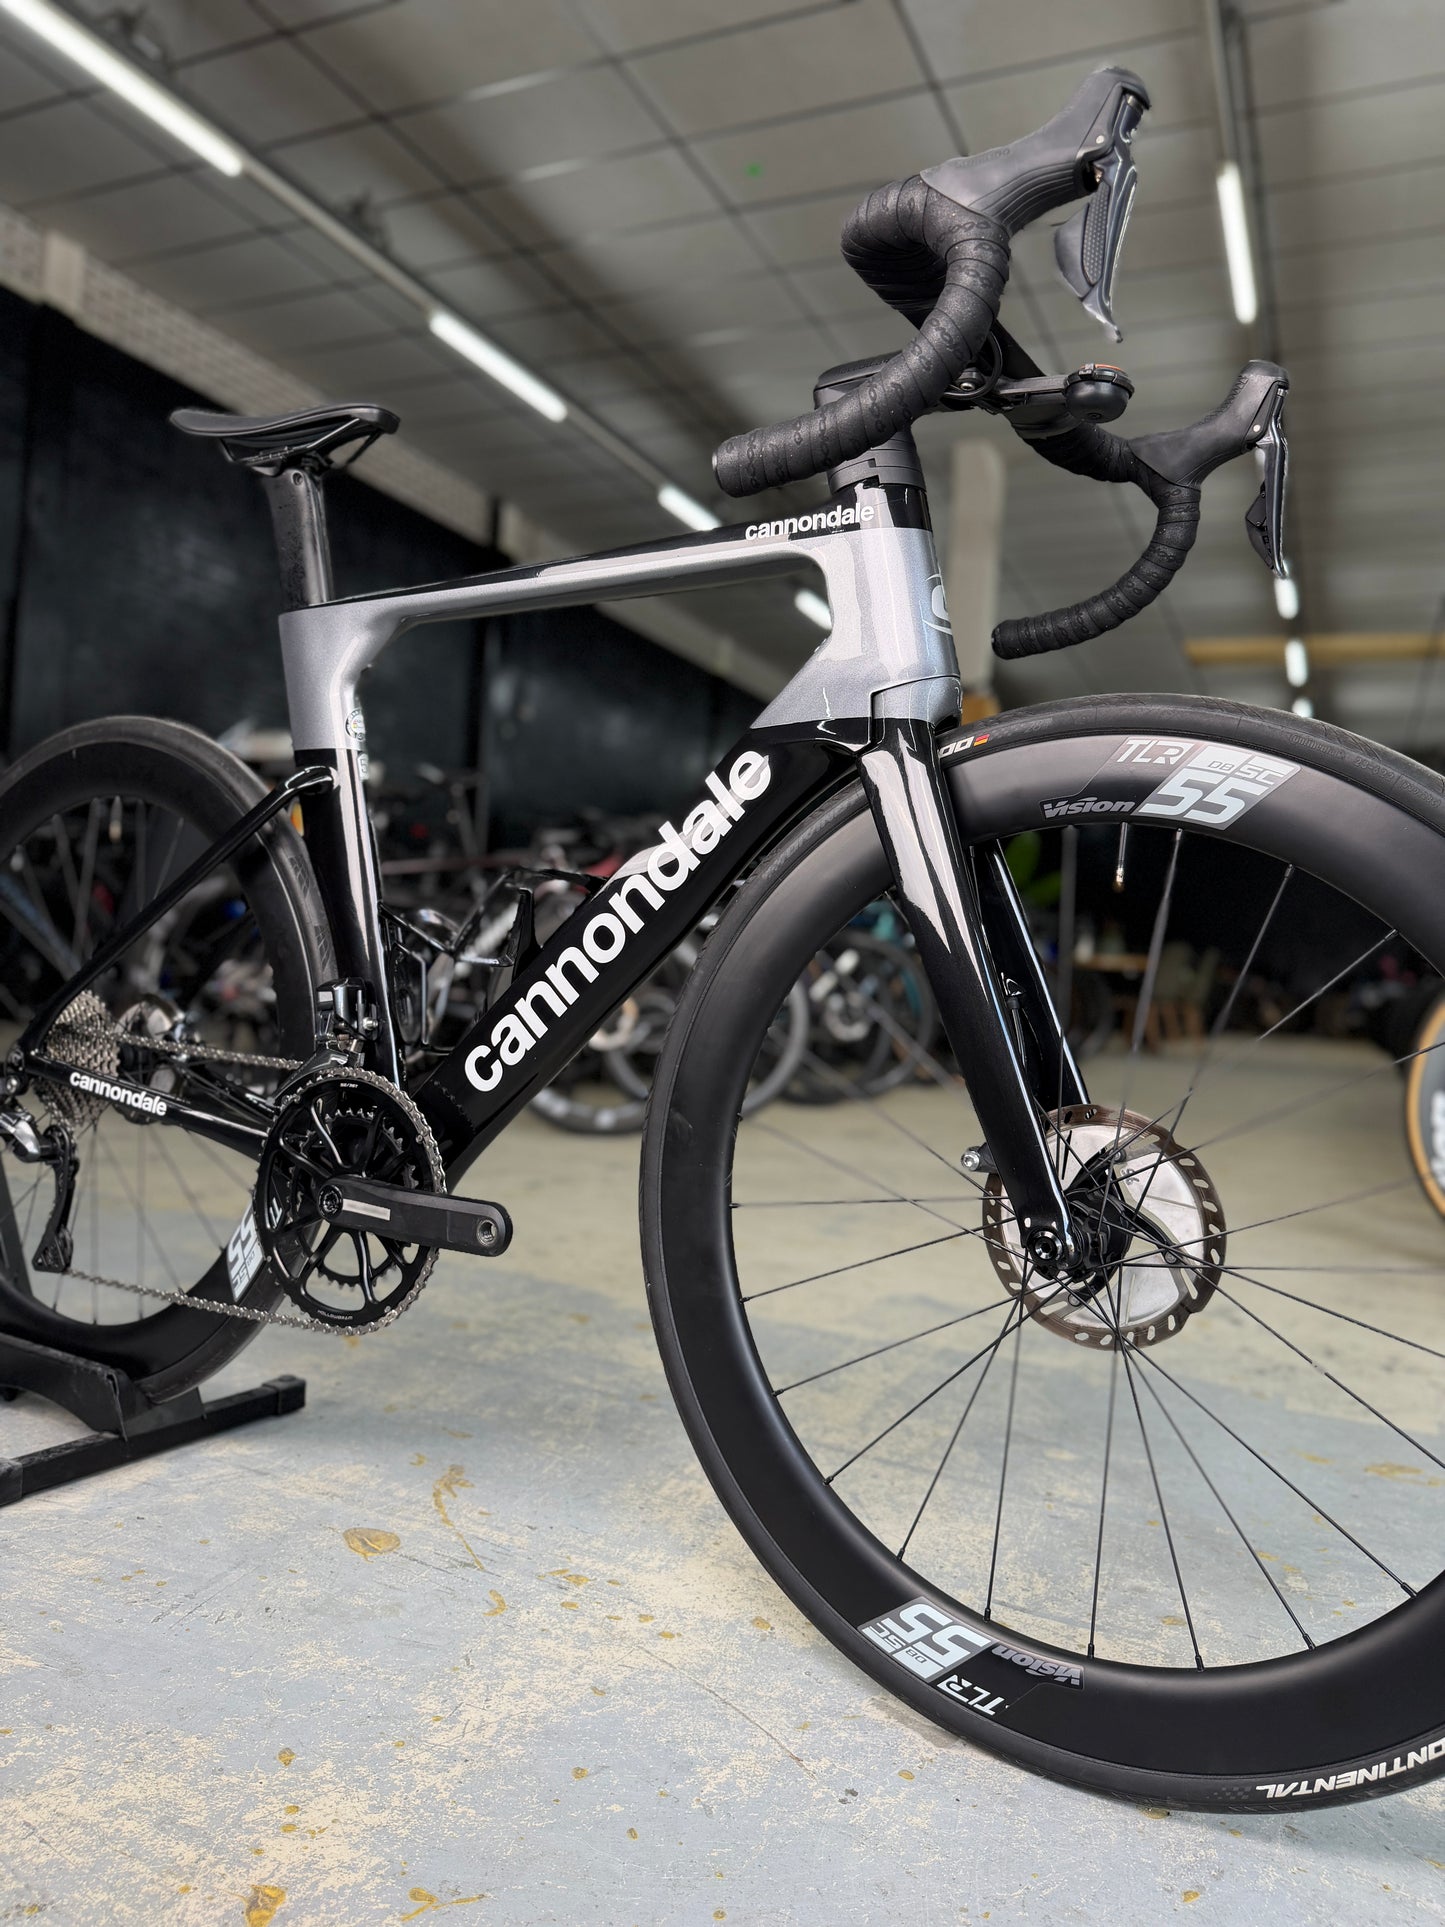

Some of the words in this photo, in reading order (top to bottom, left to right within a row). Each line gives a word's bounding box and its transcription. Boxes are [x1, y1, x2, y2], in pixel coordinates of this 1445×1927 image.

[745, 504, 875, 541] cannondale
[1116, 739, 1195, 765] TLR
[1208, 760, 1235, 772] DB
[1235, 764, 1286, 785] SC
[1138, 768, 1270, 824] 55
[464, 750, 772, 1092] cannondale
[69, 1071, 167, 1117] cannondale
[869, 1622, 906, 1651] SC
[881, 1603, 993, 1668] 55
[905, 1648, 928, 1664] DB
[936, 1674, 1005, 1716] TLR
